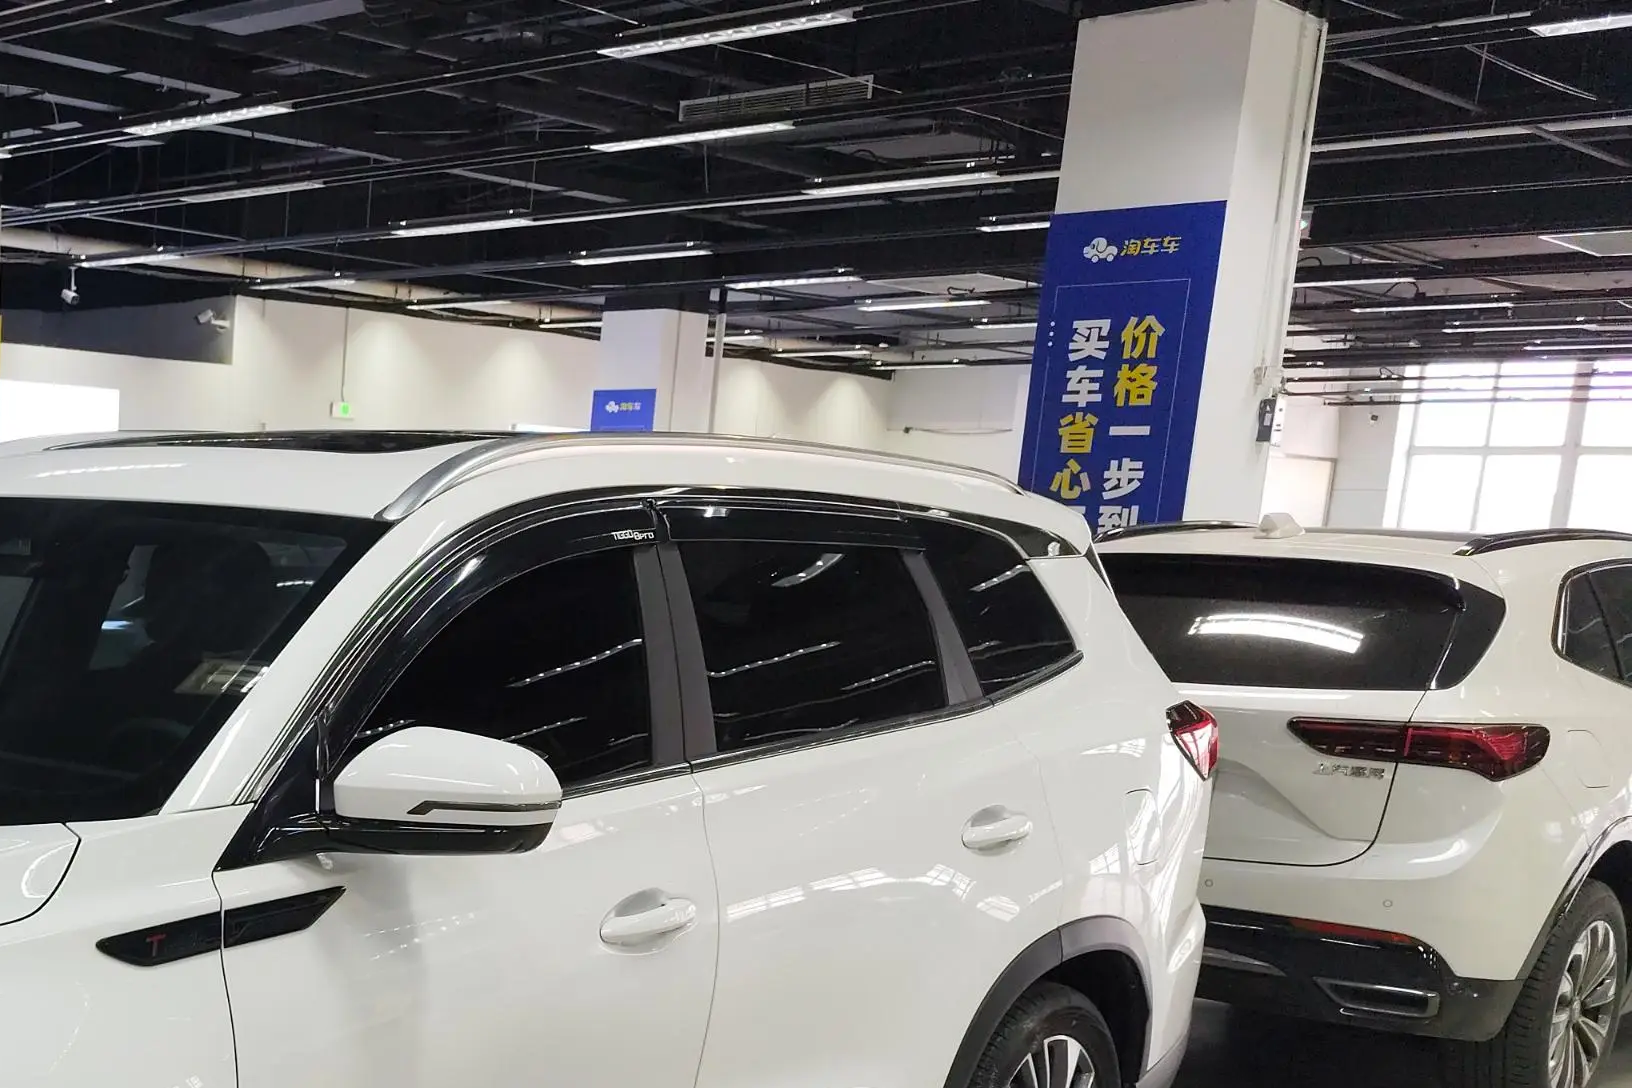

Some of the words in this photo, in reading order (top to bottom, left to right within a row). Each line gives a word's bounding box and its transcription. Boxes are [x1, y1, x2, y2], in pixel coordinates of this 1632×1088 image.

[1120, 235, 1182, 257] 淘车车
[1049, 318, 1111, 514] 买车省心
